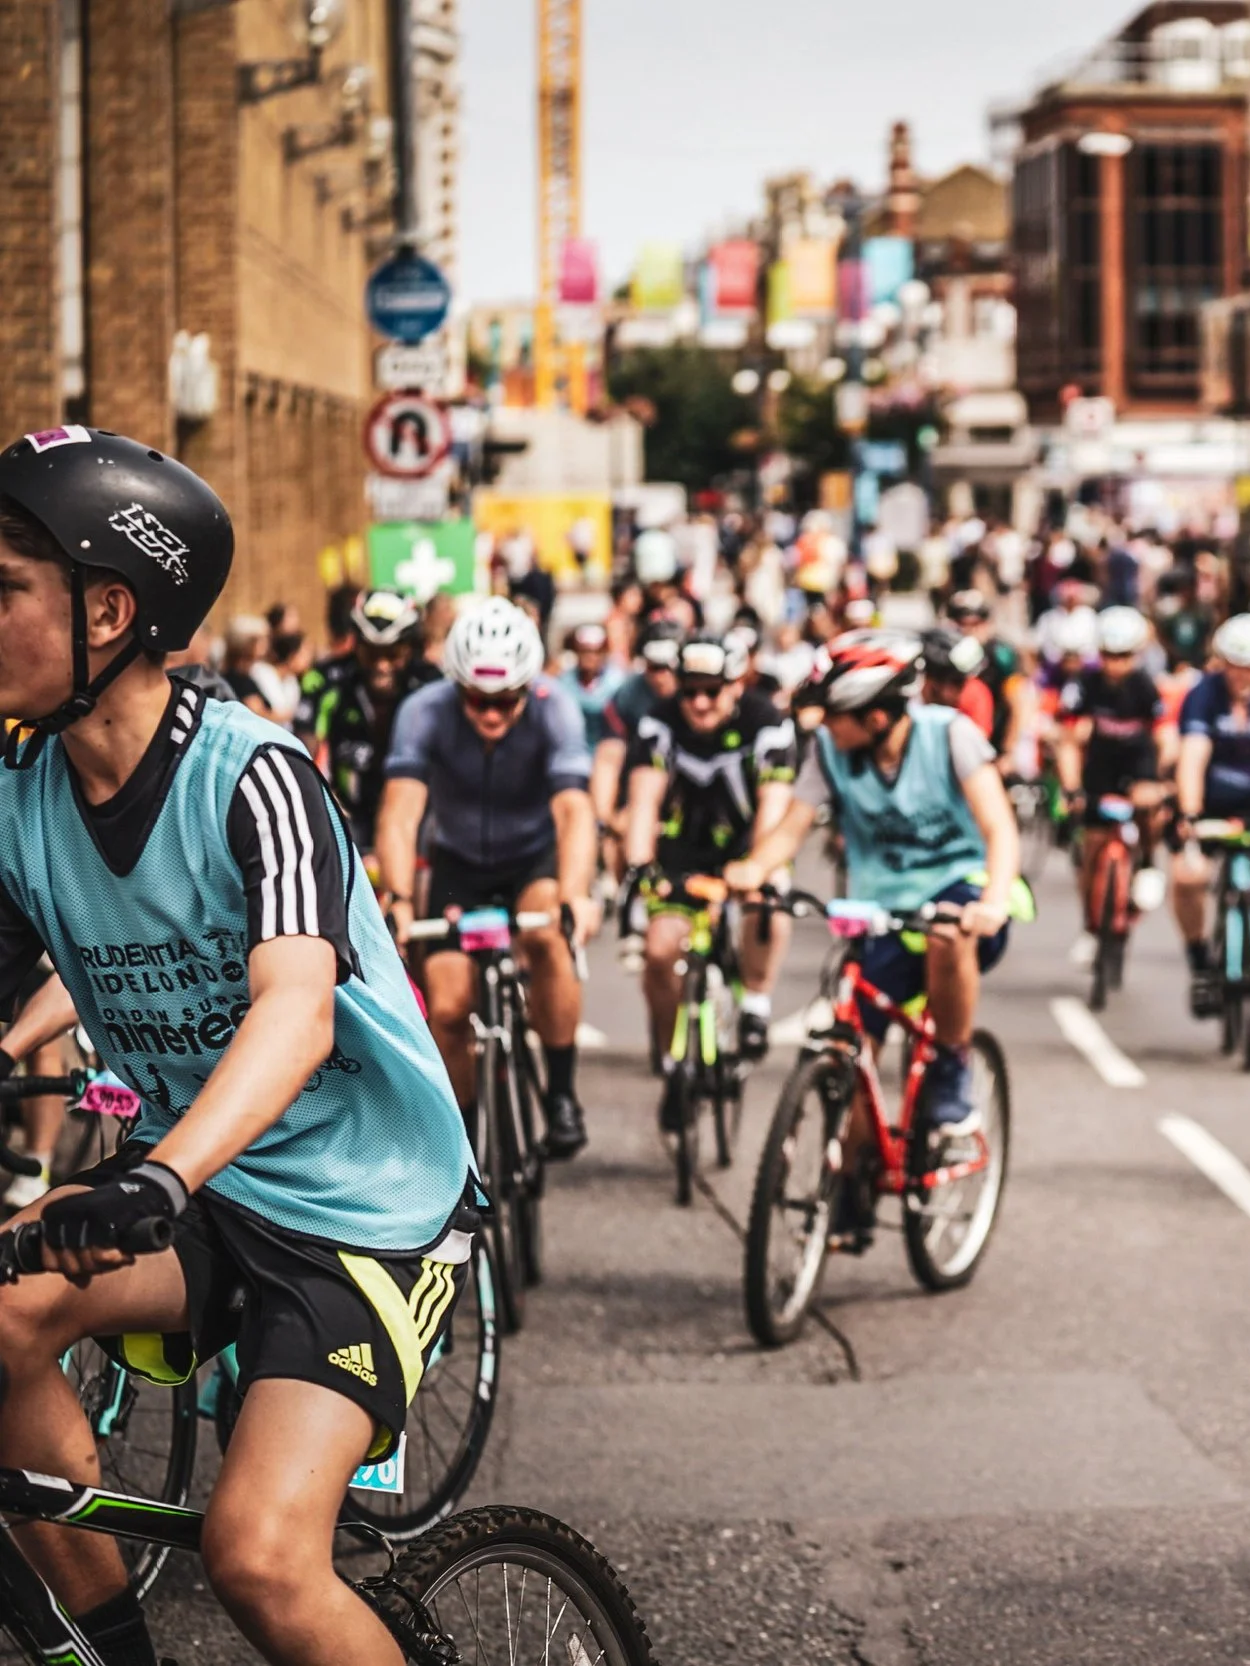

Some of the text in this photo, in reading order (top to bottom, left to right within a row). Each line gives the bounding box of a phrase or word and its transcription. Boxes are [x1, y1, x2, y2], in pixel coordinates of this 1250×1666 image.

[79, 938, 210, 969] RUDENTIAL
[91, 960, 248, 995] IDELONDO
[103, 1007, 169, 1023] ONDON
[104, 1003, 251, 1055] ninetee
[327, 1352, 378, 1387] adidas
